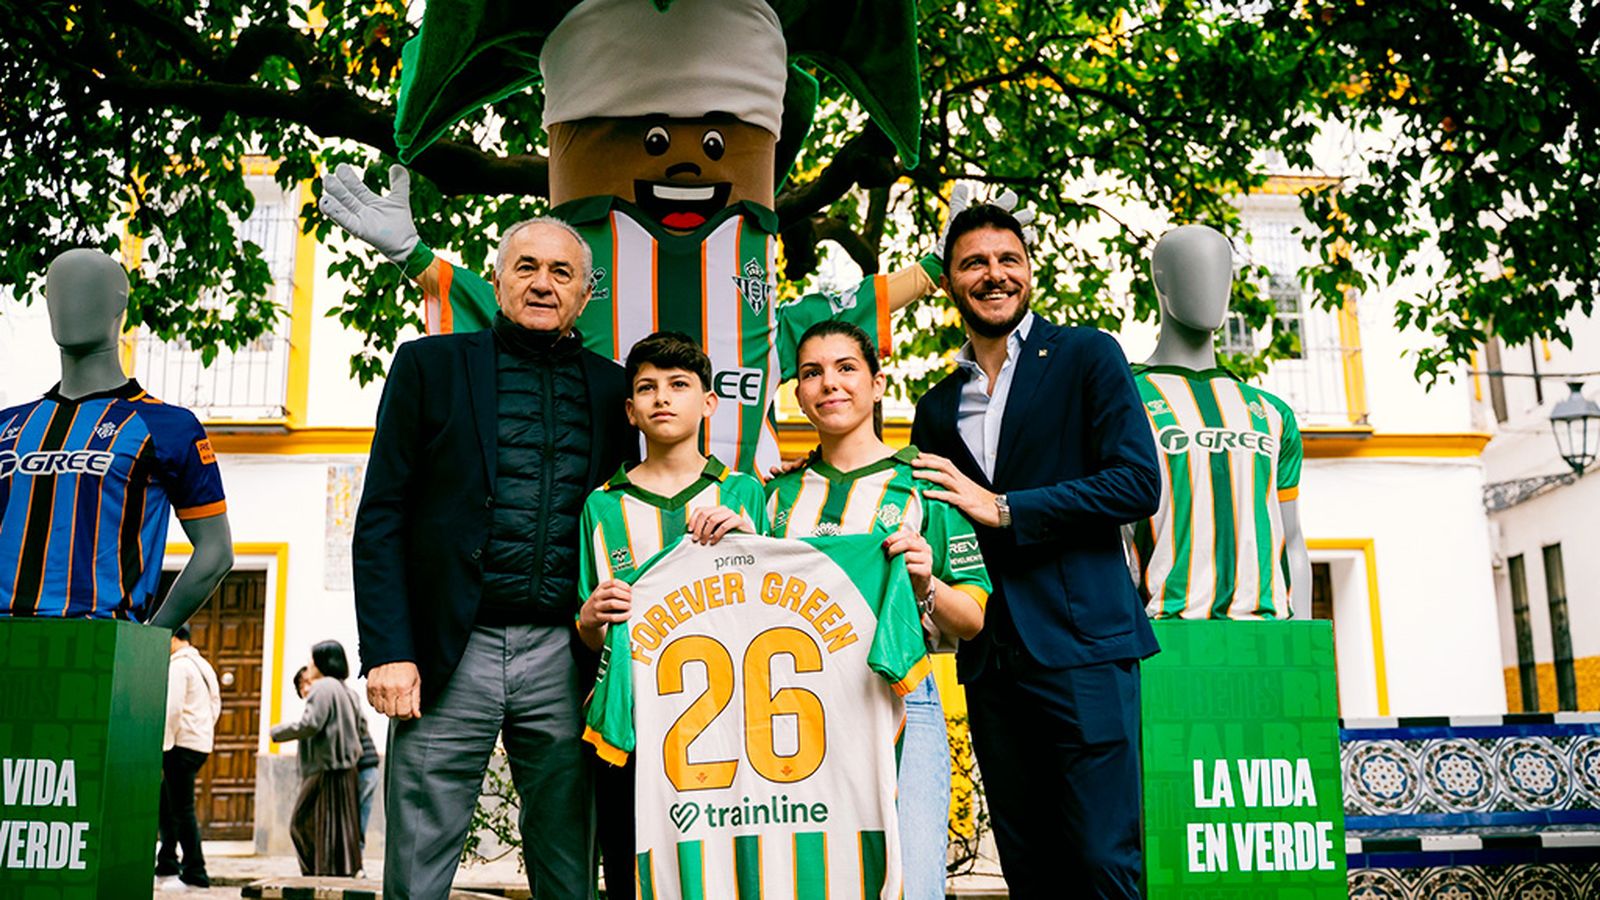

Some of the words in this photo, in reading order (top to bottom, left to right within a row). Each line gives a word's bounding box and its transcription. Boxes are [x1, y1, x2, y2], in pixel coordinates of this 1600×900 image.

[713, 371, 761, 401] EE
[1195, 429, 1274, 454] GREE
[20, 452, 112, 474] GREE
[714, 554, 755, 570] prima
[630, 572, 746, 666] FOREVER
[760, 571, 860, 654] GREEN
[656, 626, 827, 792] 26
[2, 758, 77, 807] VIDA
[1193, 759, 1235, 808] LA
[1237, 758, 1317, 807] VIDA
[704, 794, 829, 828] trainline
[1187, 823, 1228, 872] EN
[1232, 822, 1336, 871] VERDE
